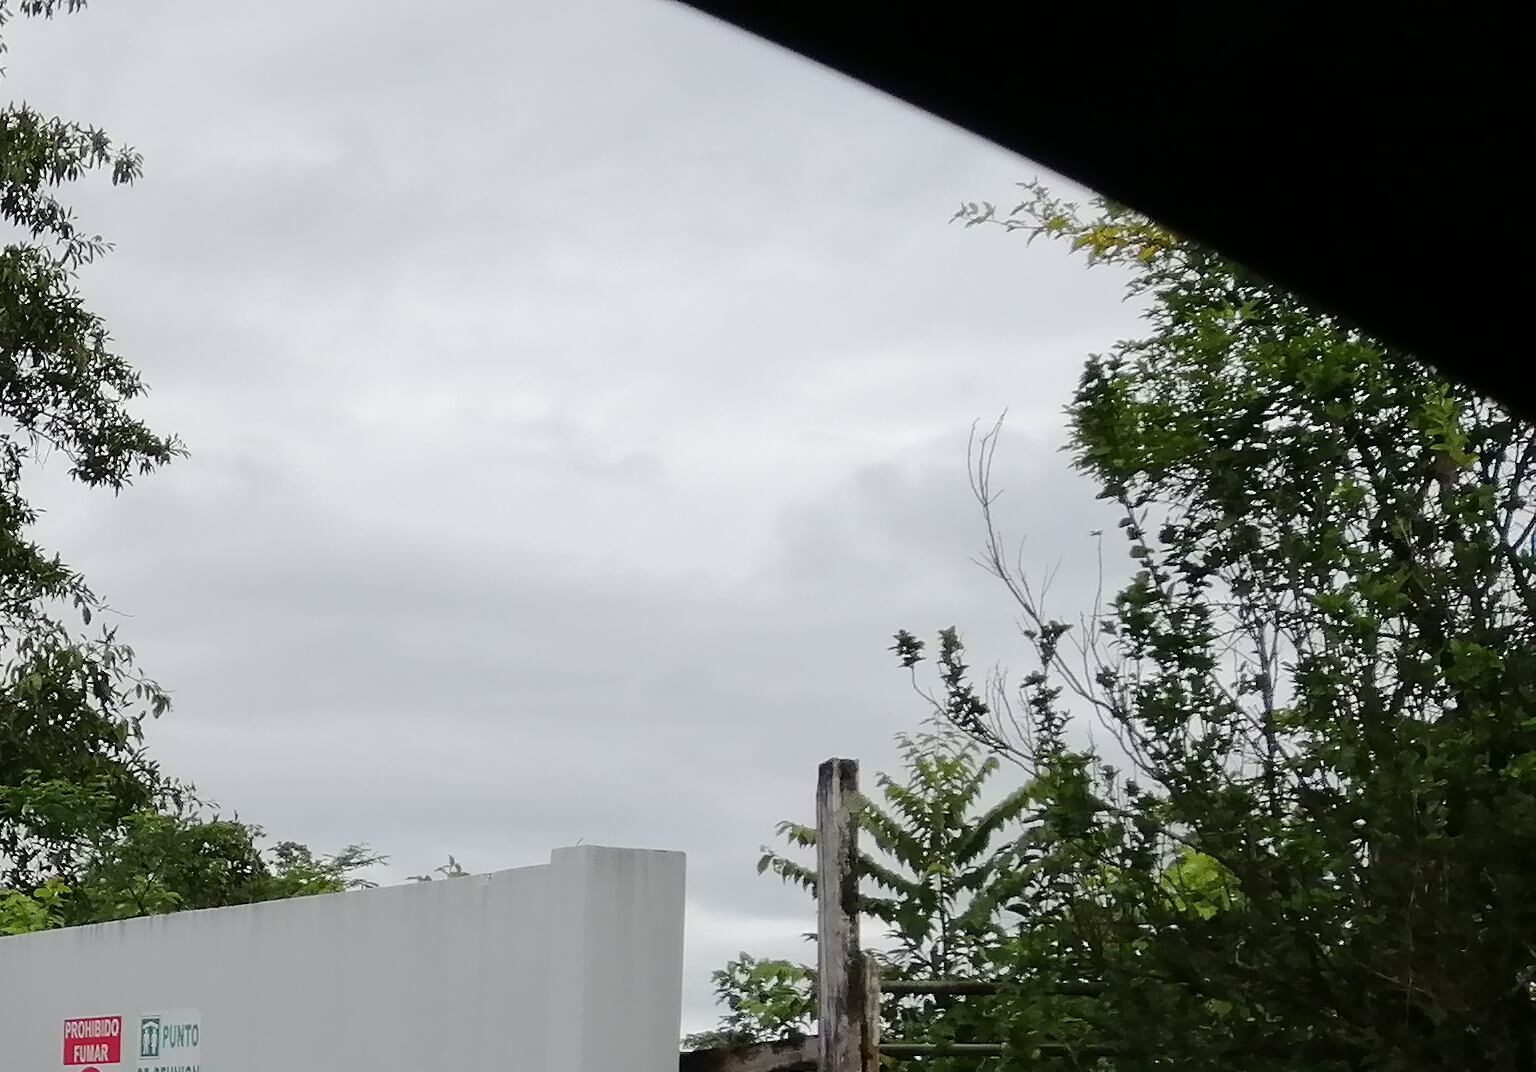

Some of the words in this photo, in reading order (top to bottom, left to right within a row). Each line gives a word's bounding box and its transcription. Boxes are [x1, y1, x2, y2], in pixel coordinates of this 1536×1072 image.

[65, 1018, 119, 1039] PROHIBIDO
[162, 1024, 199, 1048] PUNTO
[73, 1043, 109, 1063] FUMAR
